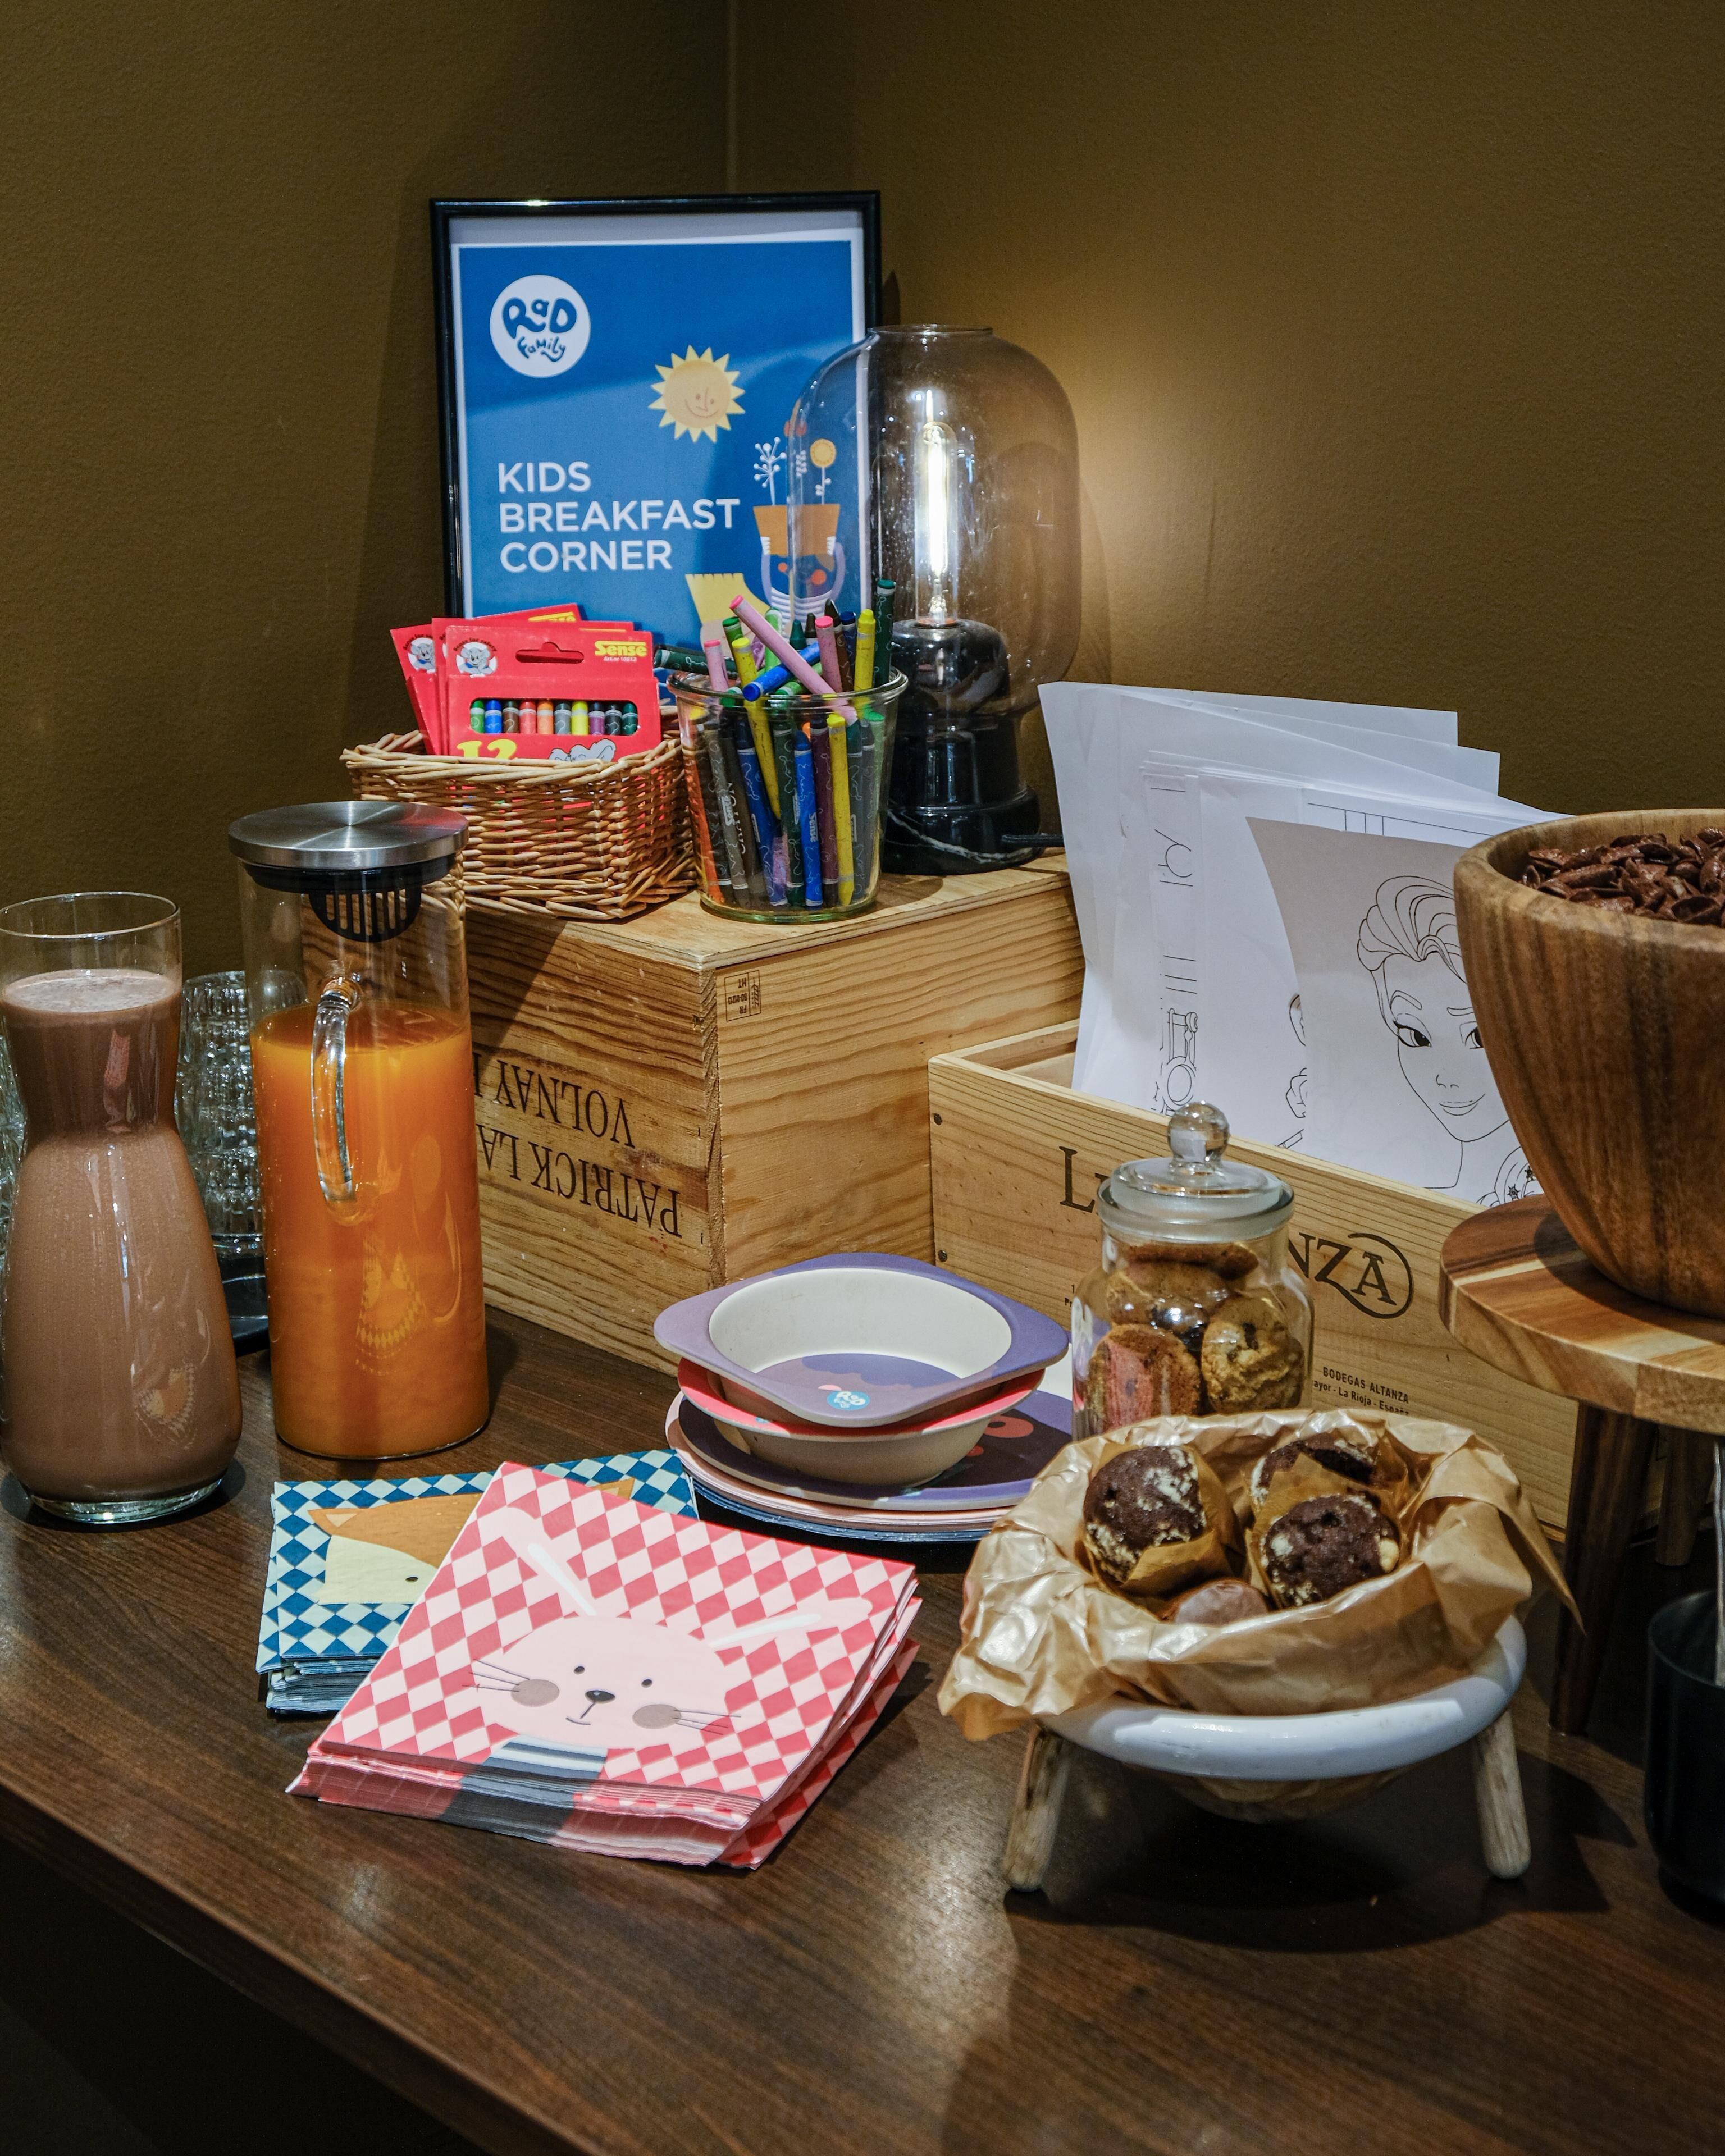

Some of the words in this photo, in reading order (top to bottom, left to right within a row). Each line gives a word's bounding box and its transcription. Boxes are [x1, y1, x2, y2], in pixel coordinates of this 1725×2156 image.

[498, 461, 591, 494] KIDS
[500, 498, 741, 533] BREAKFAST
[500, 540, 672, 573] CORNER
[595, 641, 647, 657] Sense
[457, 738, 517, 759] 12
[809, 812, 818, 842] Sense
[738, 977, 747, 988] HT
[492, 1059, 636, 1148] VOLNAY
[528, 1141, 682, 1238] PATRICK
[1323, 1366, 1366, 1389] BODEGAS
[1370, 1382, 1409, 1404] ALTANZA
[1339, 1387, 1348, 1398] La
[1351, 1391, 1372, 1406] Rioja
